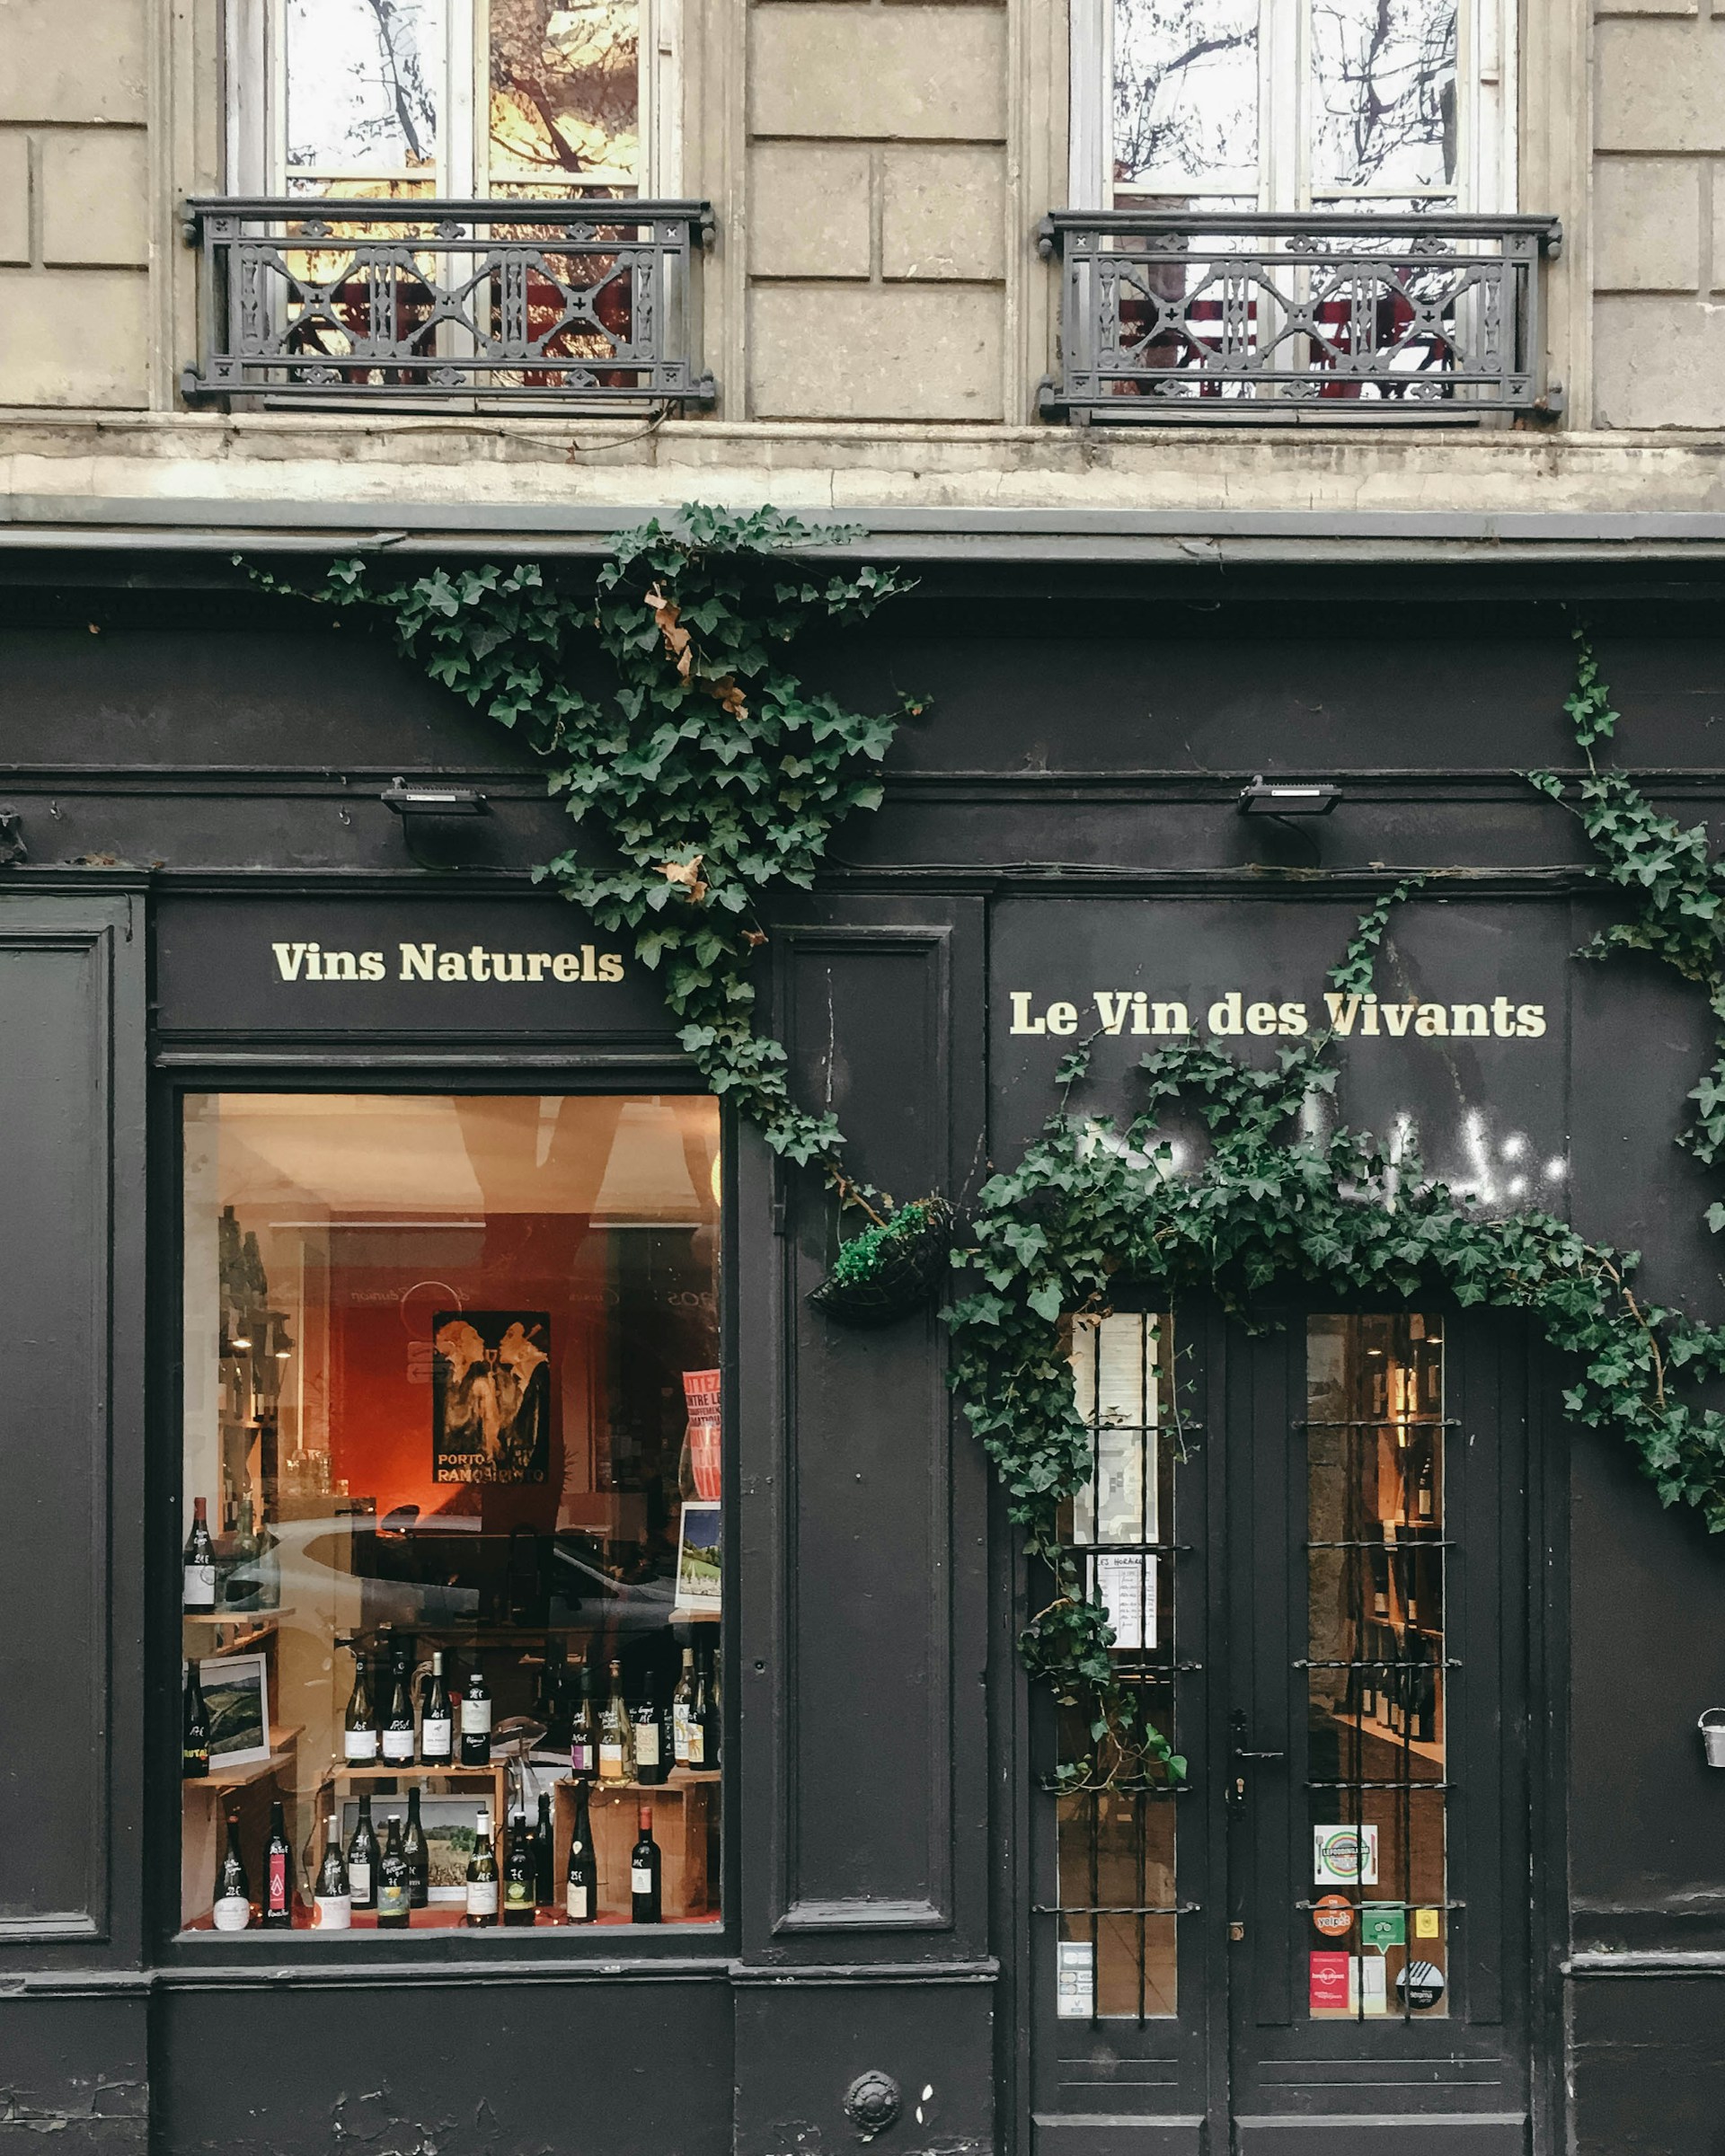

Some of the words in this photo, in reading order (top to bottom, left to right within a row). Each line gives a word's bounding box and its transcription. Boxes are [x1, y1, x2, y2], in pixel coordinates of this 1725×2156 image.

[272, 942, 386, 982] Vins
[399, 942, 625, 983] Naturels
[1009, 991, 1077, 1035] Le
[1093, 992, 1189, 1036] Vin
[1208, 991, 1308, 1037] des
[1324, 992, 1547, 1038] Vivants
[438, 1454, 485, 1465] PORTO
[510, 1869, 524, 1881] 7€
[1317, 1915, 1341, 1929] yelp
